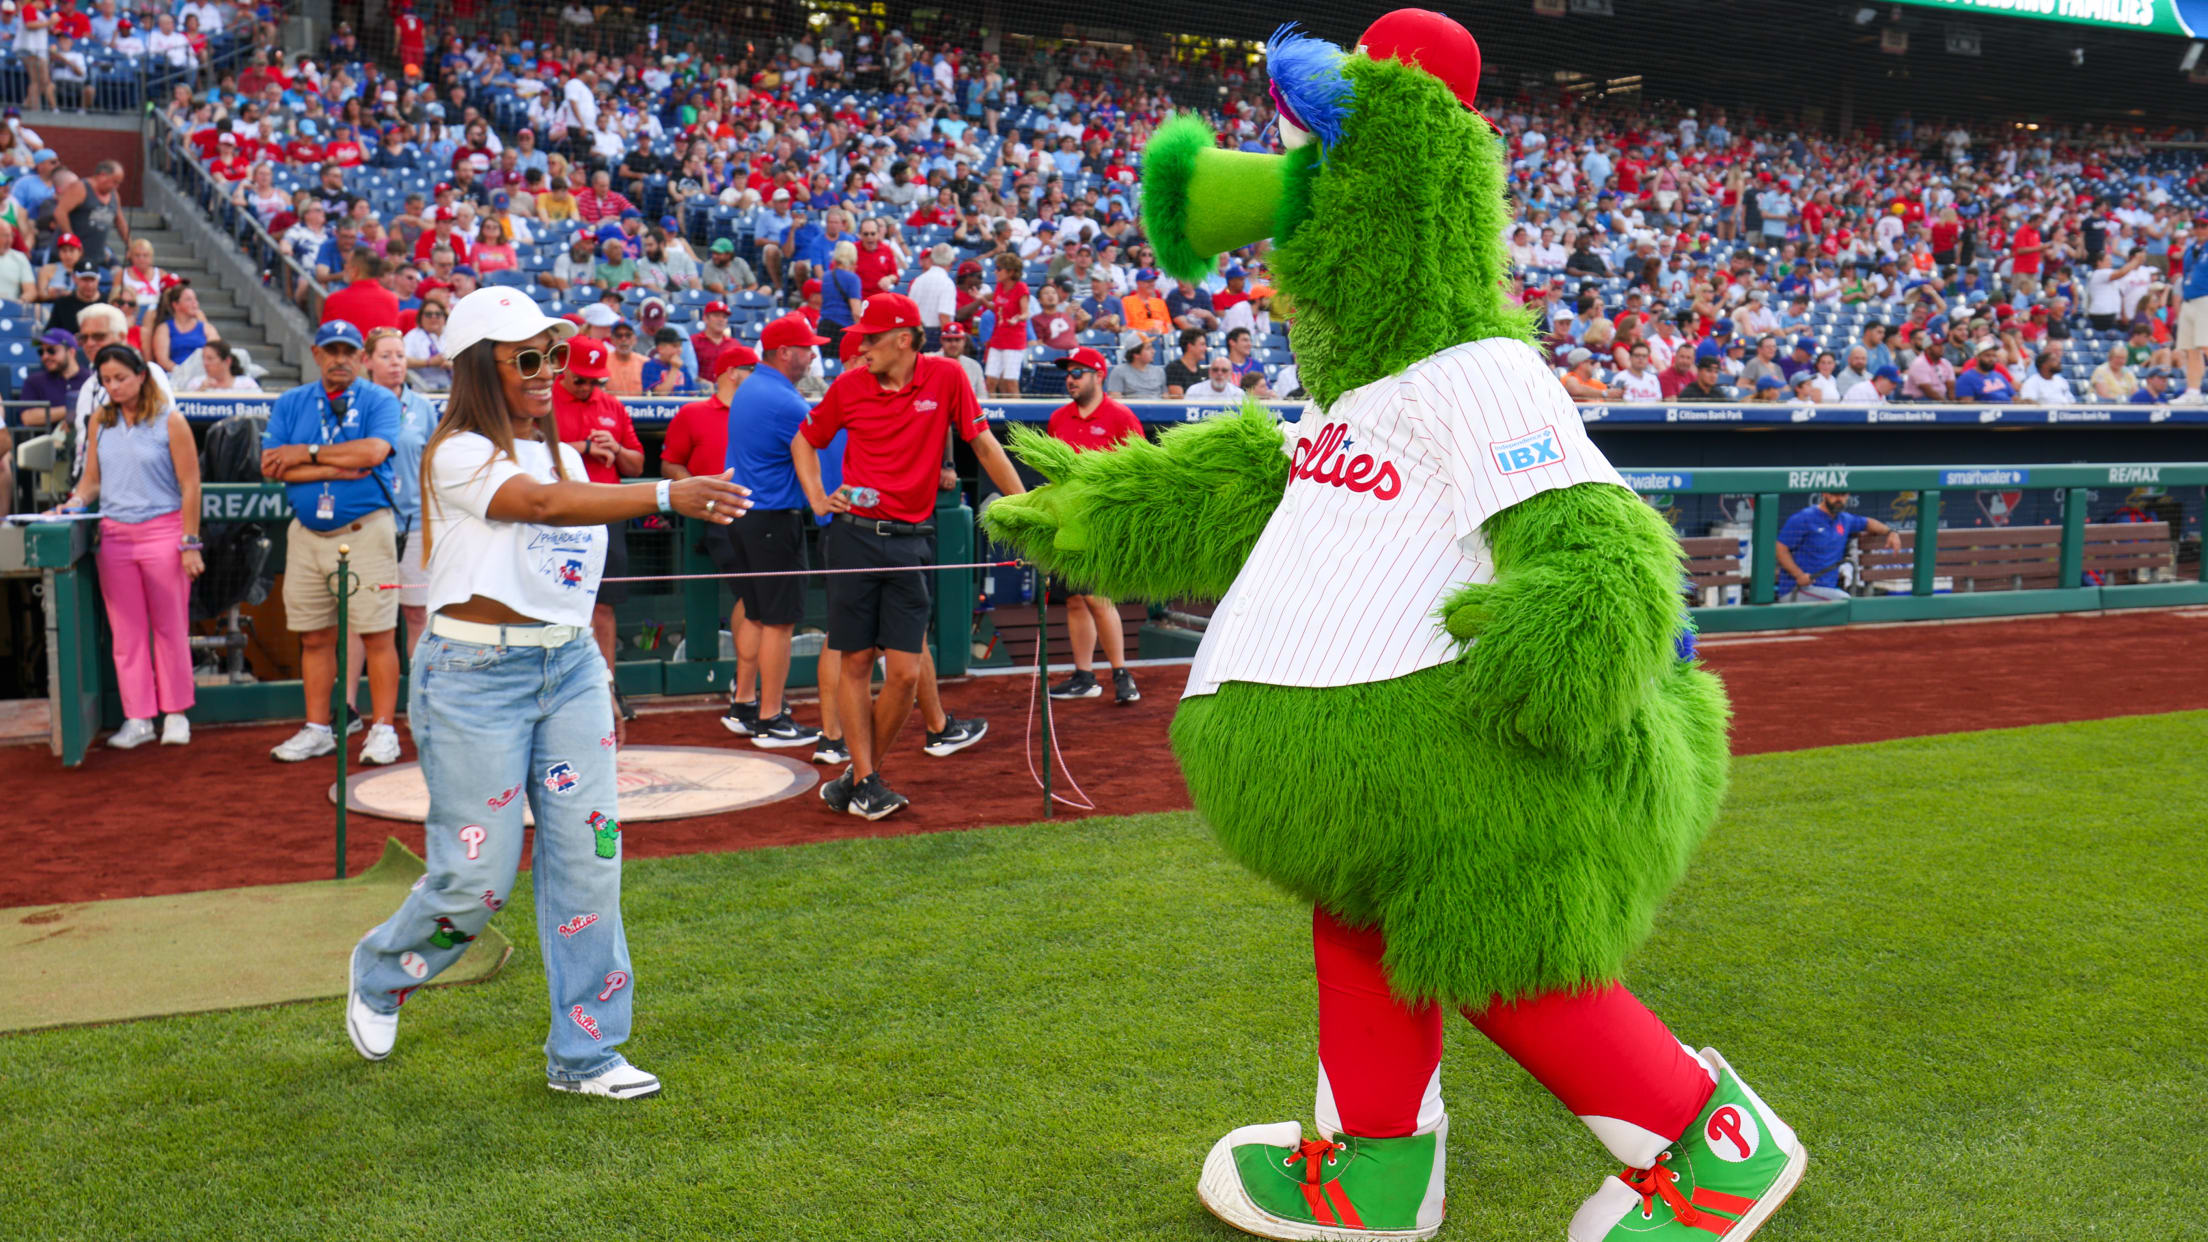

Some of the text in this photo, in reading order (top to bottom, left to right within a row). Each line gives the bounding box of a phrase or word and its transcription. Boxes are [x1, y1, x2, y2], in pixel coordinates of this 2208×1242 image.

[176, 402, 271, 417] Citizens Bank
[983, 407, 1005, 419] Park
[1497, 437, 1560, 472] IBX
[1625, 473, 1671, 490] twater
[1788, 470, 1848, 489] RE/MAX
[1946, 470, 2012, 486] smartwater
[2108, 467, 2160, 484] RE/MAX
[202, 493, 293, 518] RE/M
[458, 824, 488, 861] P
[558, 913, 599, 939] Phillies
[598, 970, 628, 1002] P
[568, 1005, 602, 1041] Phillies
[1708, 1106, 1751, 1159] P
